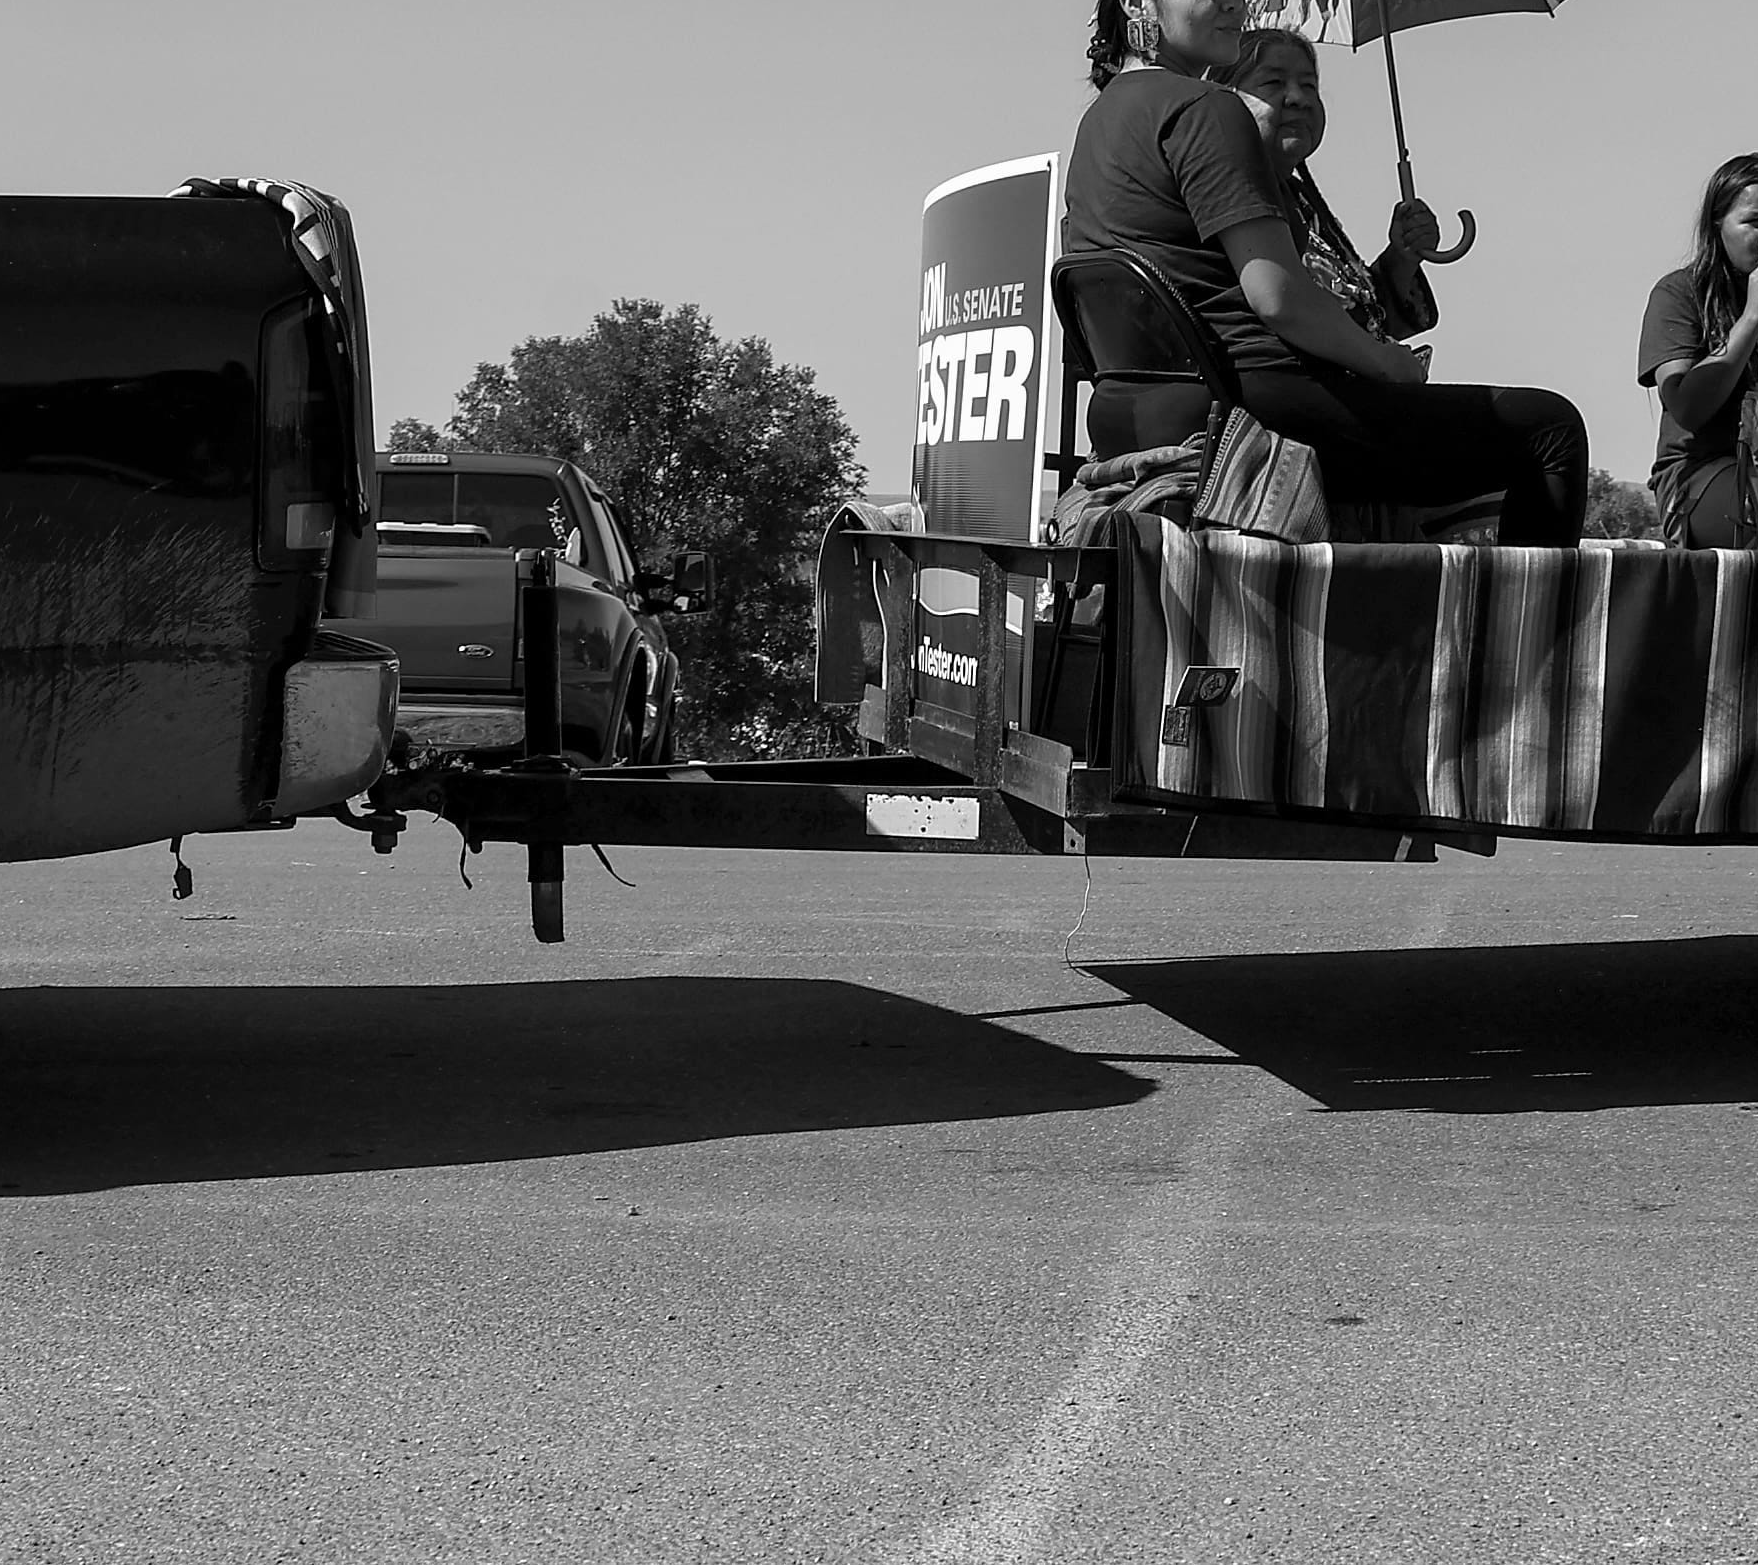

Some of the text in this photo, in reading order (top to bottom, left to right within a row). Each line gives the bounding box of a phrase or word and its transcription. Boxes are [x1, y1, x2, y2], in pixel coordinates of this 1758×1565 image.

[946, 292, 961, 327] U.S.
[962, 282, 1025, 324] SENATE
[917, 325, 1035, 446] ESTER
[911, 635, 979, 687] nTester.com
